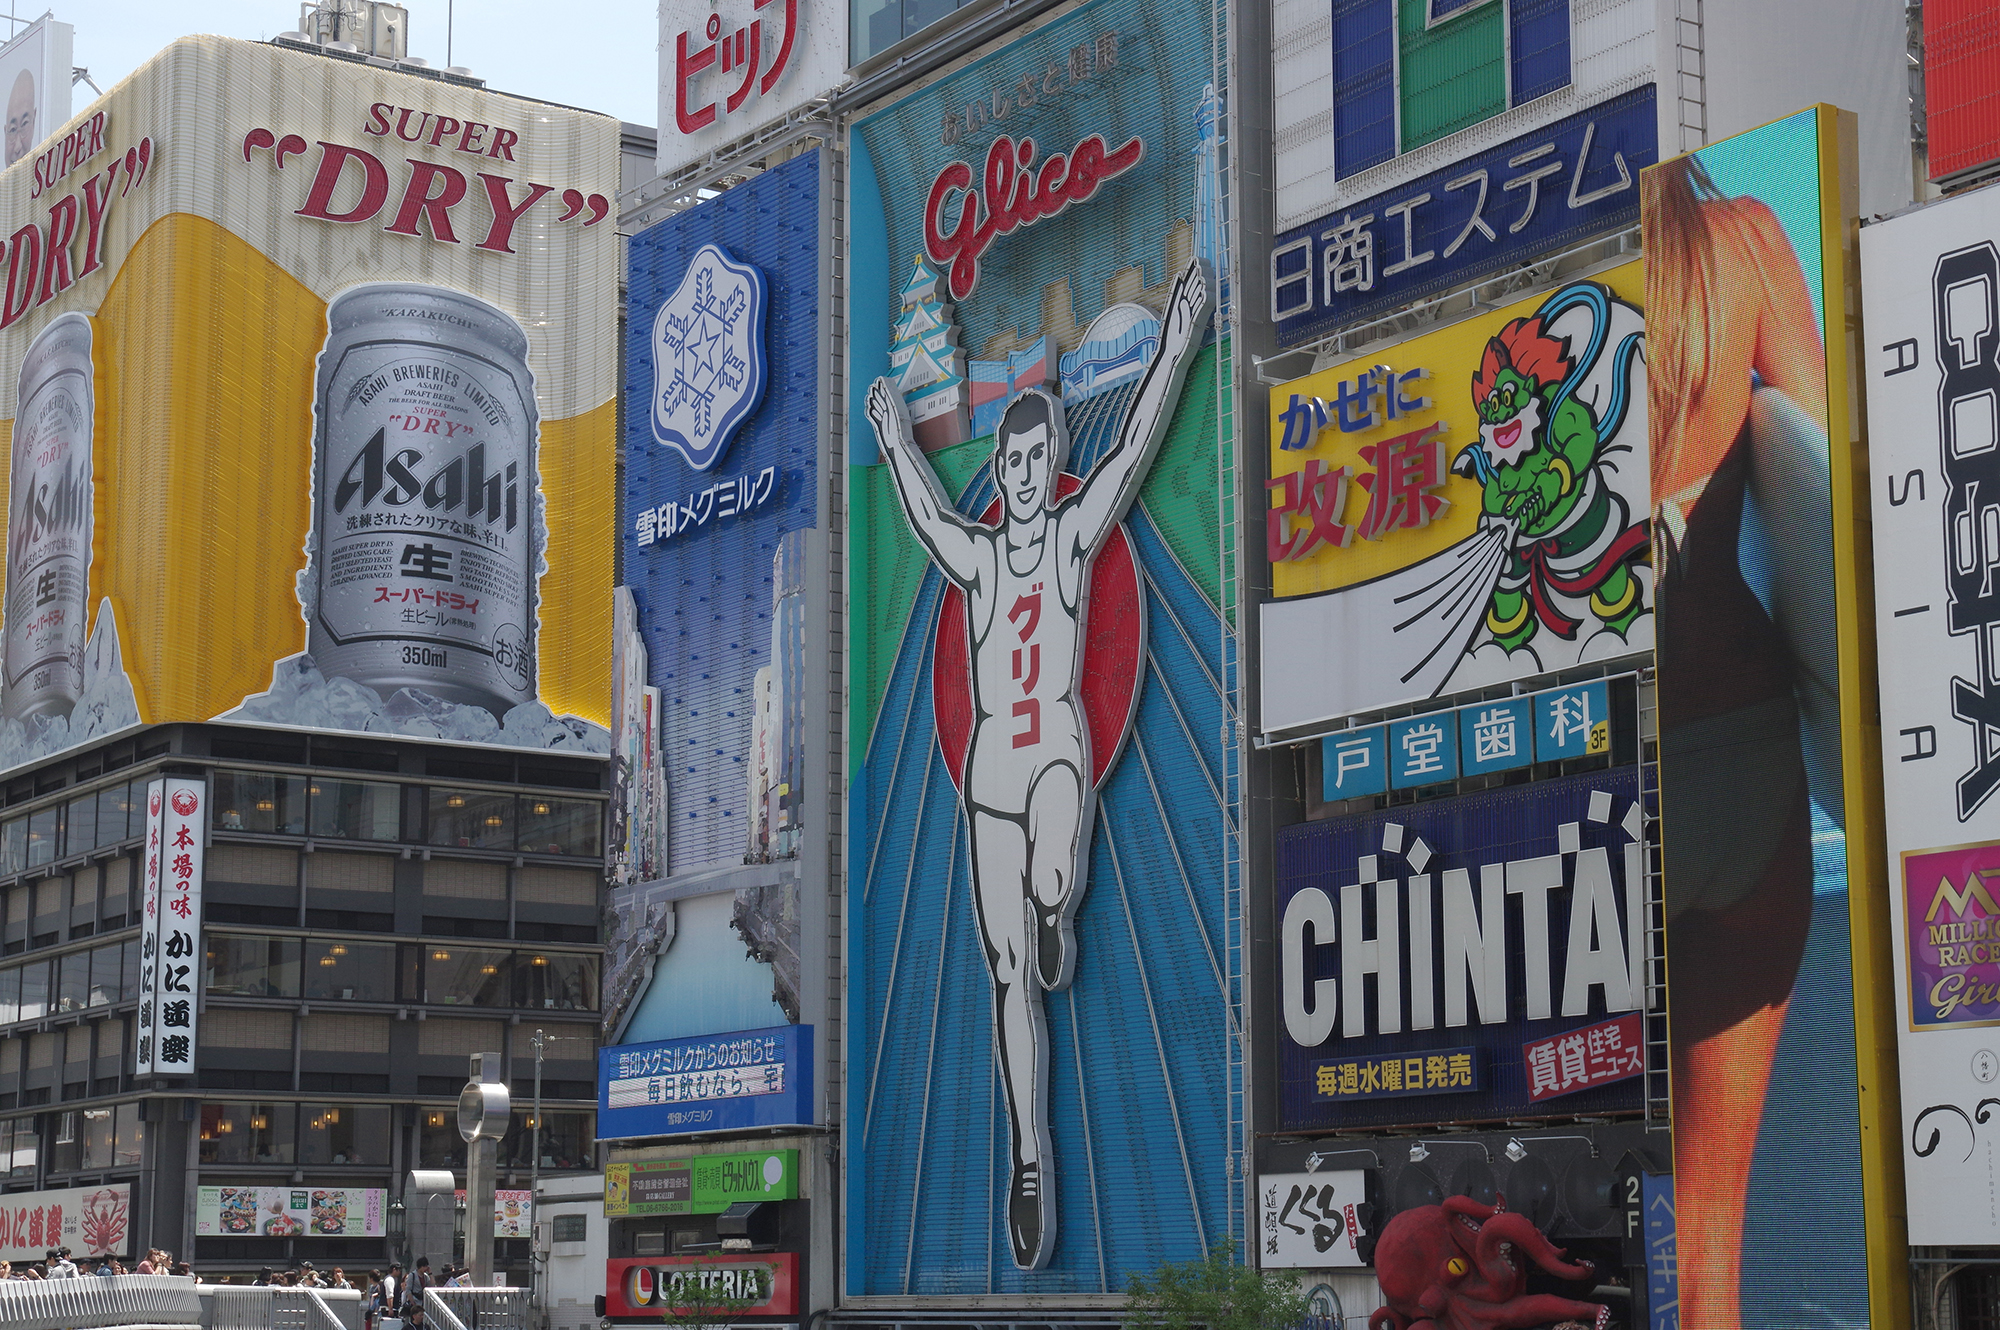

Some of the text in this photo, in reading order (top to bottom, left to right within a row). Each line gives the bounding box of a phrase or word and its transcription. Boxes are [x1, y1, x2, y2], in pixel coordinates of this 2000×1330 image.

[940, 29, 1119, 147] おいしさと健康
[32, 111, 108, 200] SUPER
[364, 102, 518, 162] SUPER
[924, 132, 1148, 302] Glico
[1270, 121, 1632, 324] 日商エステム
[357, 364, 501, 427] ASAHI BREWERIES LIMITED
[404, 388, 456, 403] DRAFT BEER
[412, 406, 448, 418] SUPER
[416, 381, 444, 391] ASAHI
[1279, 364, 1430, 452] かぜに
[14, 451, 85, 566] Asahi
[333, 424, 518, 535] Asahi
[635, 465, 777, 548] 雪印メグミルク
[1266, 421, 1450, 563] 改源
[36, 568, 57, 608] 生
[400, 543, 454, 583] 生
[25, 609, 66, 640] スーパードライ
[373, 587, 480, 615] スーパードライ
[402, 646, 447, 668] 350ml
[1006, 583, 1044, 750] グリコ
[1334, 691, 1594, 790] 戸堂歯科
[1590, 729, 1607, 750] 3F
[147, 824, 160, 920] 本場の味
[169, 824, 195, 920] 本場の味
[619, 1036, 776, 1079] 雪印メグミルクからのお知らせ
[1316, 1053, 1472, 1096] 毎週水曜日発売
[1527, 1023, 1643, 1097] 賃貸 住宅 ニュース
[667, 1109, 713, 1126] 雪印メグミルク
[722, 1159, 760, 1193] ピタットハウス
[1626, 1175, 1641, 1239] 2F
[1264, 1183, 1279, 1256] 道頓堀
[1279, 1183, 1345, 1254] くくる
